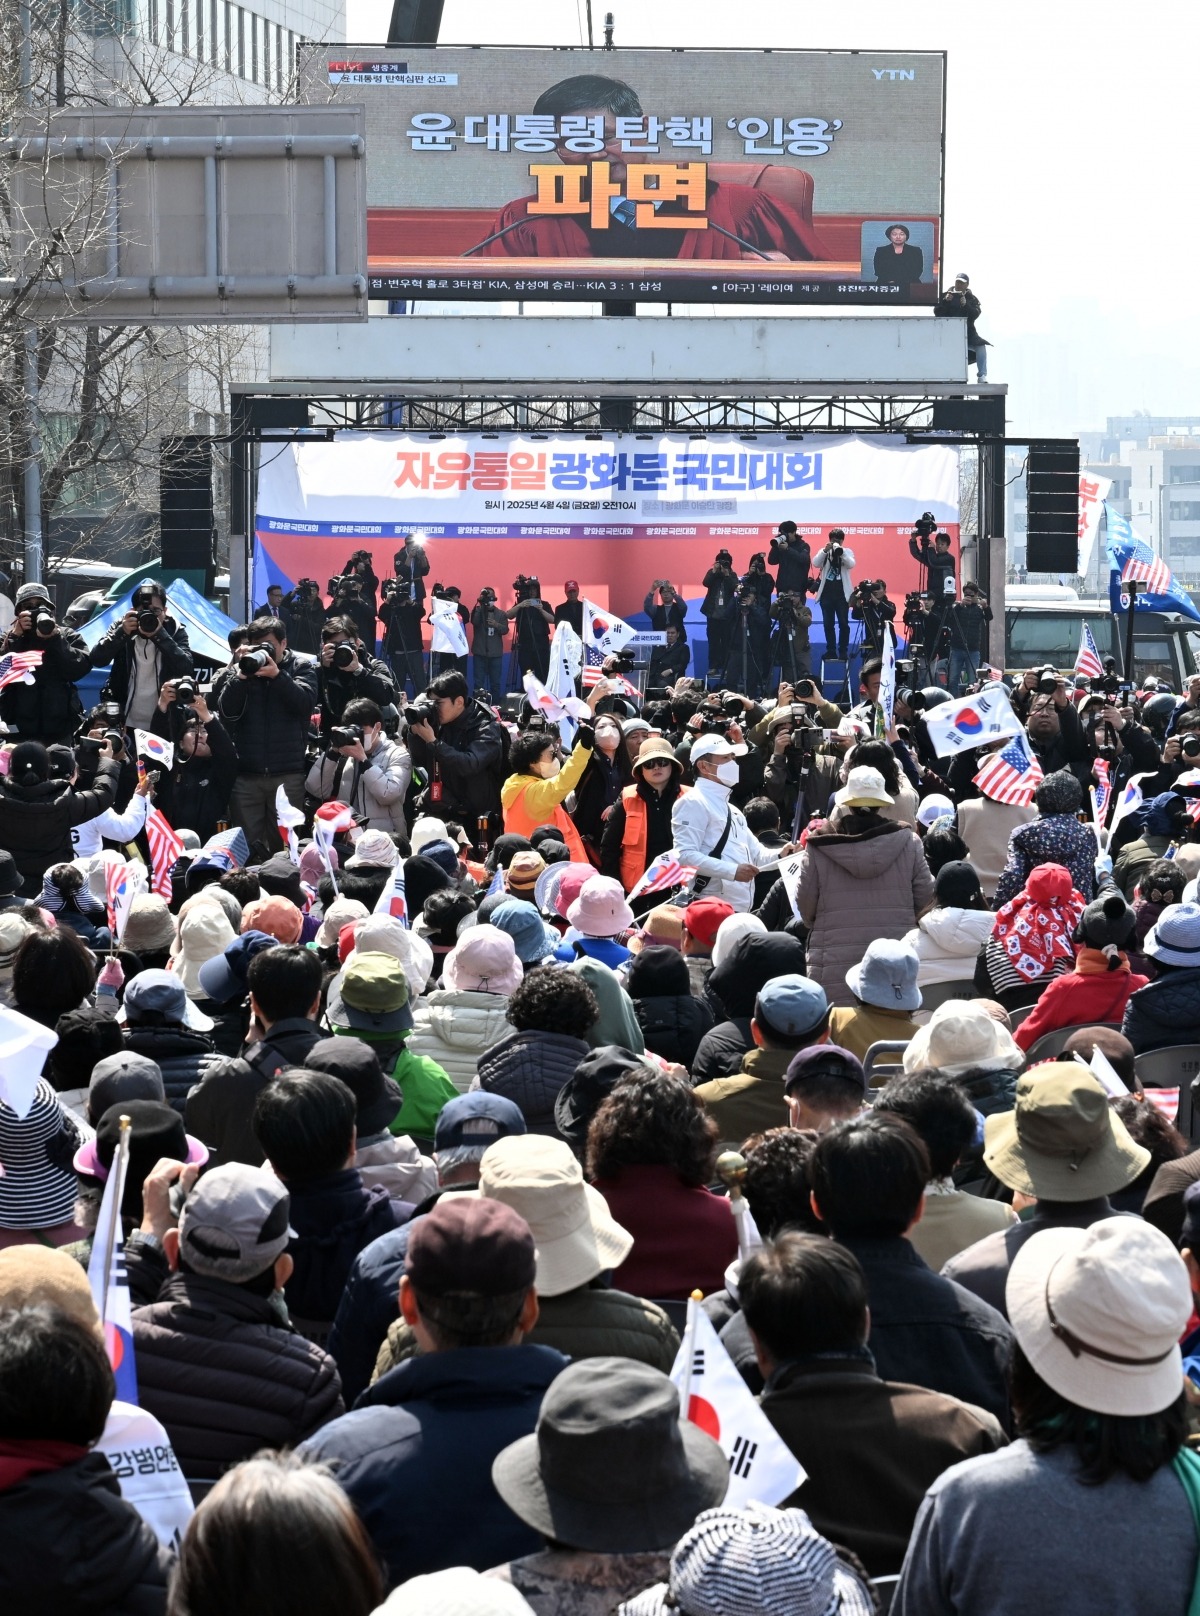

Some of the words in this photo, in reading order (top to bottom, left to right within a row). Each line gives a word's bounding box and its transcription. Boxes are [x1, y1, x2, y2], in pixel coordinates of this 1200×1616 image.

[371, 63, 399, 72] 생중계
[353, 74, 383, 83] 대통령
[385, 74, 424, 84] 탄핵심판
[426, 75, 447, 83] 선고
[871, 69, 915, 81] YTN
[406, 112, 456, 151] 윤
[464, 114, 606, 154] 대통령
[615, 115, 713, 155] 탄핵
[526, 160, 709, 230] 파면
[488, 280, 511, 291] KIA,
[514, 280, 549, 290] 삼성에
[609, 281, 617, 291] 3
[629, 282, 635, 290] 1
[639, 281, 663, 292] 삼성
[722, 282, 755, 293] [야구]
[837, 284, 900, 293] 유진투자증권
[394, 452, 547, 492] 자유통일
[673, 453, 823, 492] 국민대회
[484, 500, 501, 510] 일시
[506, 500, 539, 510] 2025년
[540, 500, 555, 510] 4월
[555, 500, 570, 510] 4일
[572, 500, 601, 511] (금요일)
[268, 520, 319, 533] 광화문국민대회
[331, 524, 382, 534] 광화문국민대회
[457, 526, 508, 535] 광화문국민대회
[520, 526, 571, 535] 광화문국민대회
[583, 527, 634, 536] 광화문국민대회
[646, 527, 697, 536] 광화문국민대회
[709, 527, 759, 536] 광화문국민대회
